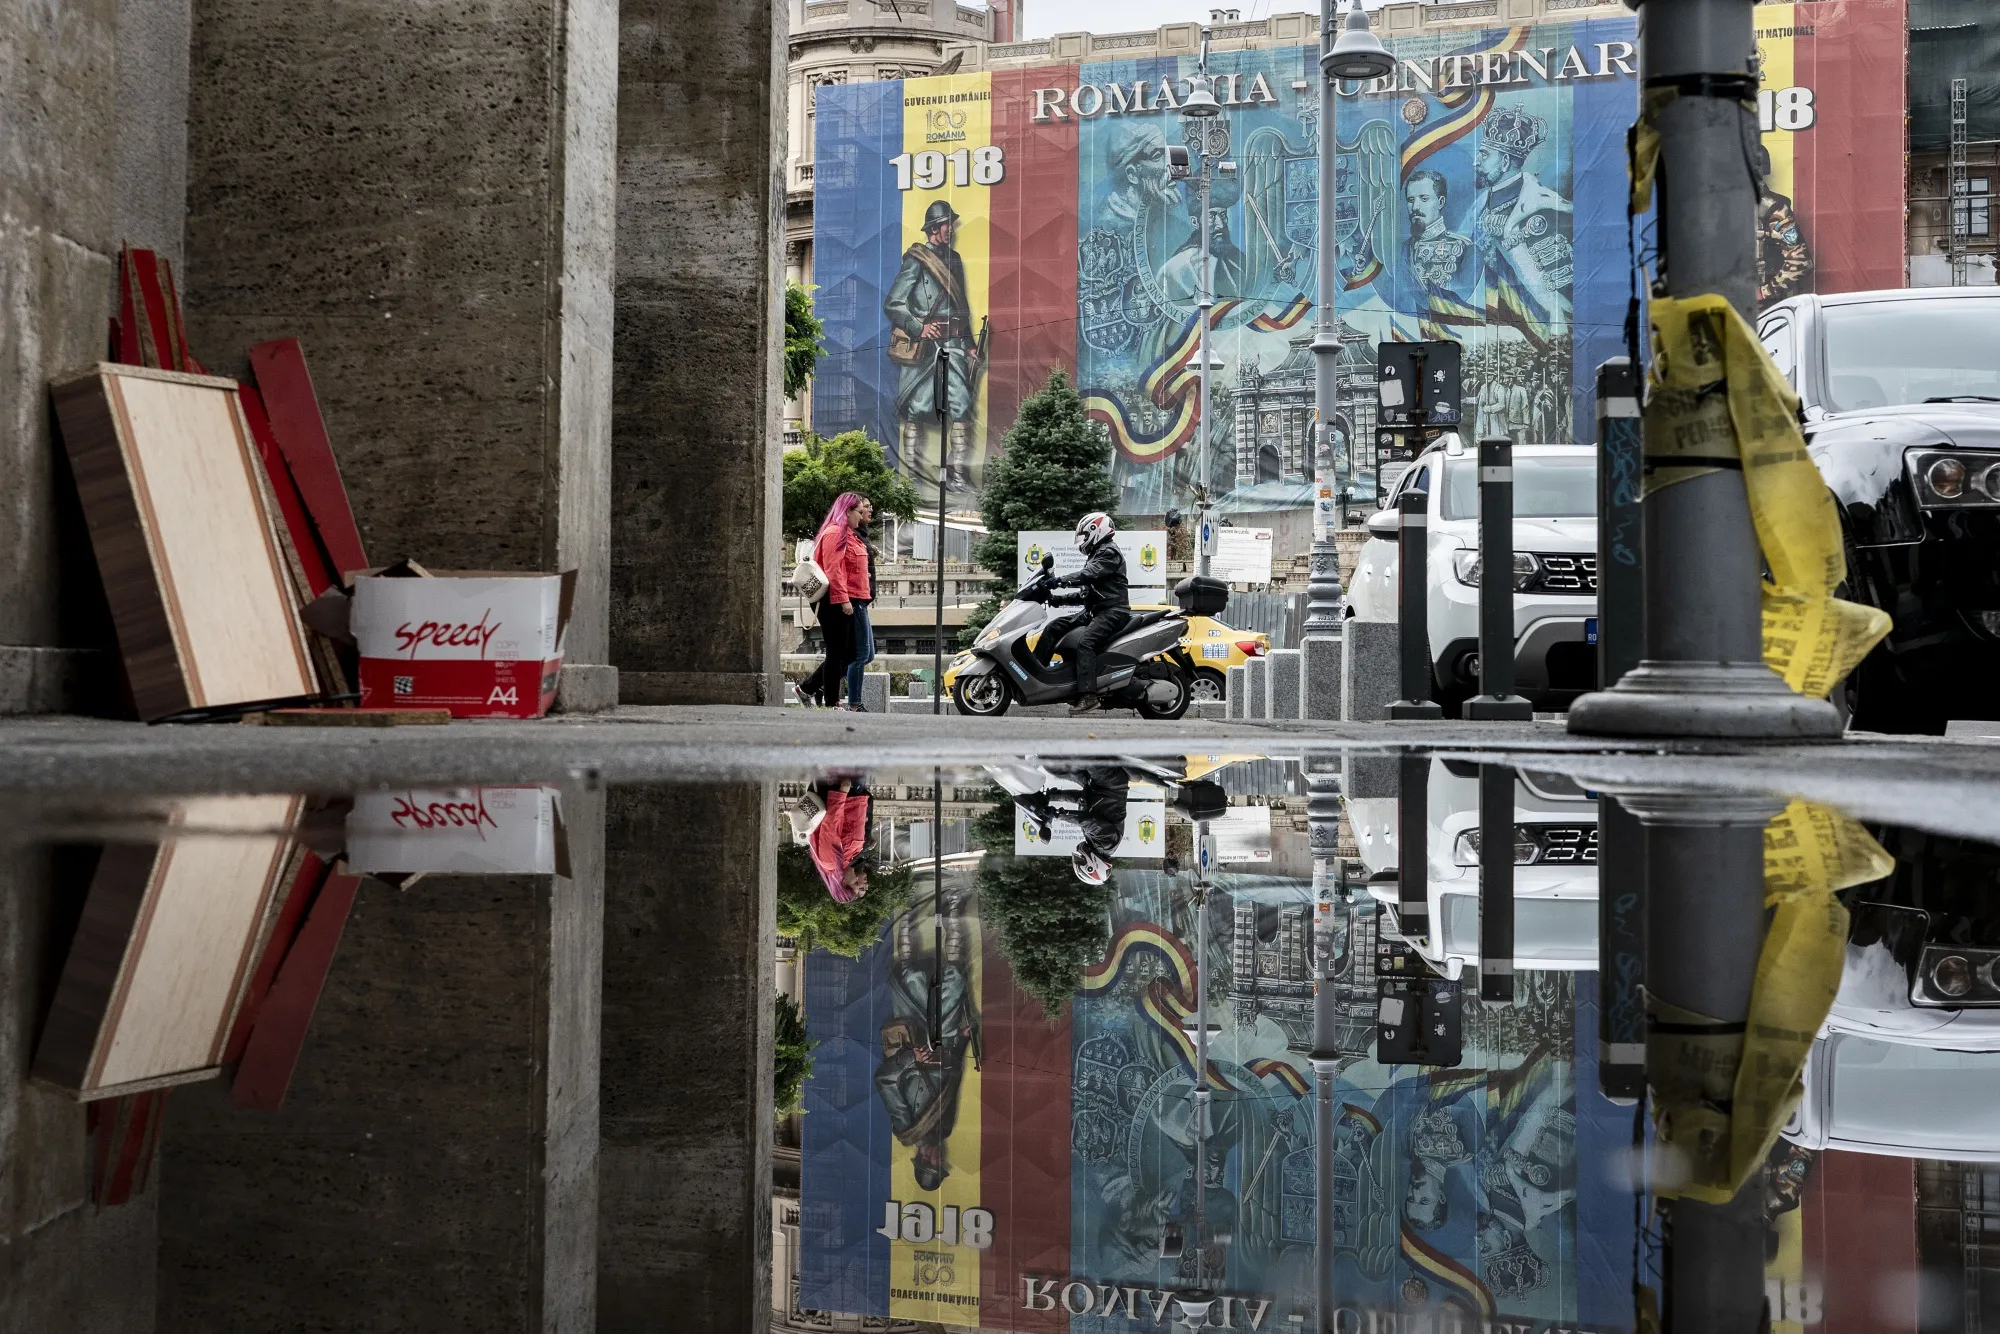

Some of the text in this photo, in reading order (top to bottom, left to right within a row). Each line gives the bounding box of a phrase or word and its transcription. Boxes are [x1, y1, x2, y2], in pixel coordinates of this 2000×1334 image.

[904, 91, 991, 107] GUVERNUL ROMÂNIEI
[1757, 87, 1815, 131] 18
[926, 130, 966, 141] ROMÂNIA
[888, 146, 1004, 190] 1918
[394, 608, 502, 660] speedy
[1587, 633, 1597, 641] RO
[486, 686, 520, 706] A4
